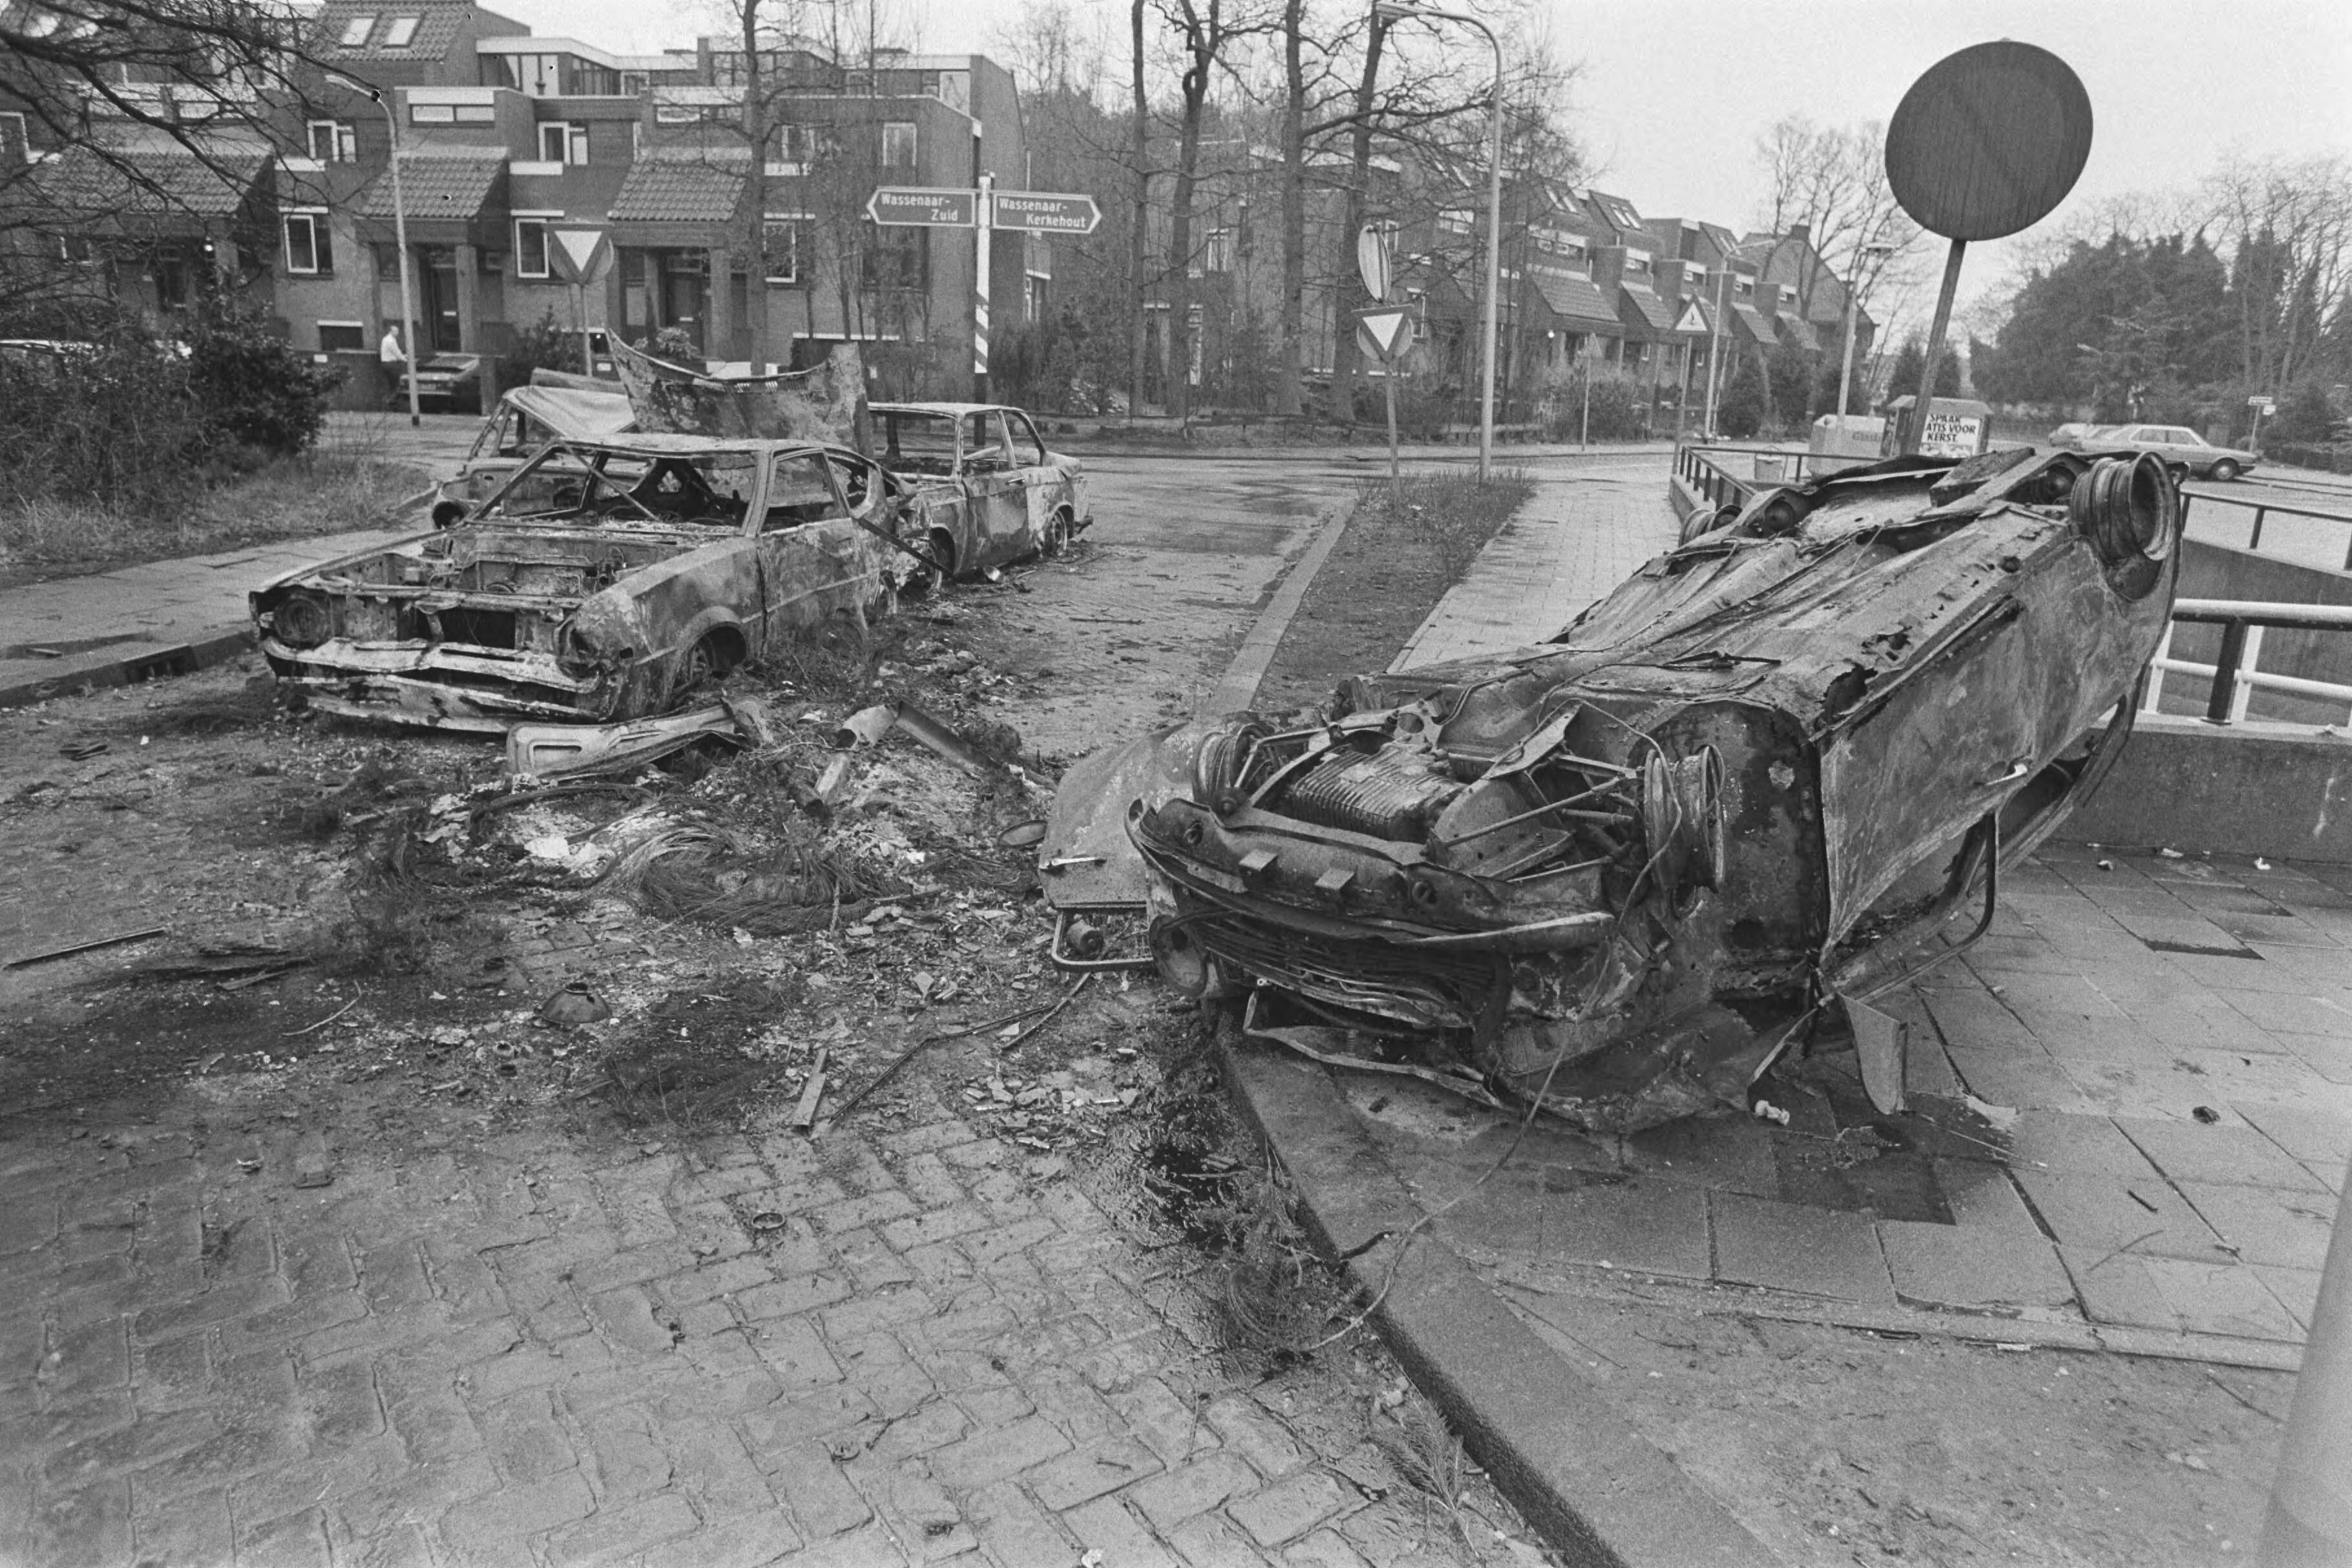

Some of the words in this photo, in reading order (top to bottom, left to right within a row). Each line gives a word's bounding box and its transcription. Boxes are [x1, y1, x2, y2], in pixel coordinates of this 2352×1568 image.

[881, 193, 951, 207] Wassenaar-
[999, 198, 1067, 213] Wassenaar-
[931, 209, 958, 222] Zuid
[1027, 213, 1086, 228] Kerkehout
[1925, 423, 1947, 432] ATIS
[1949, 424, 1977, 434] VOOR
[1927, 432, 1957, 442] KERST
